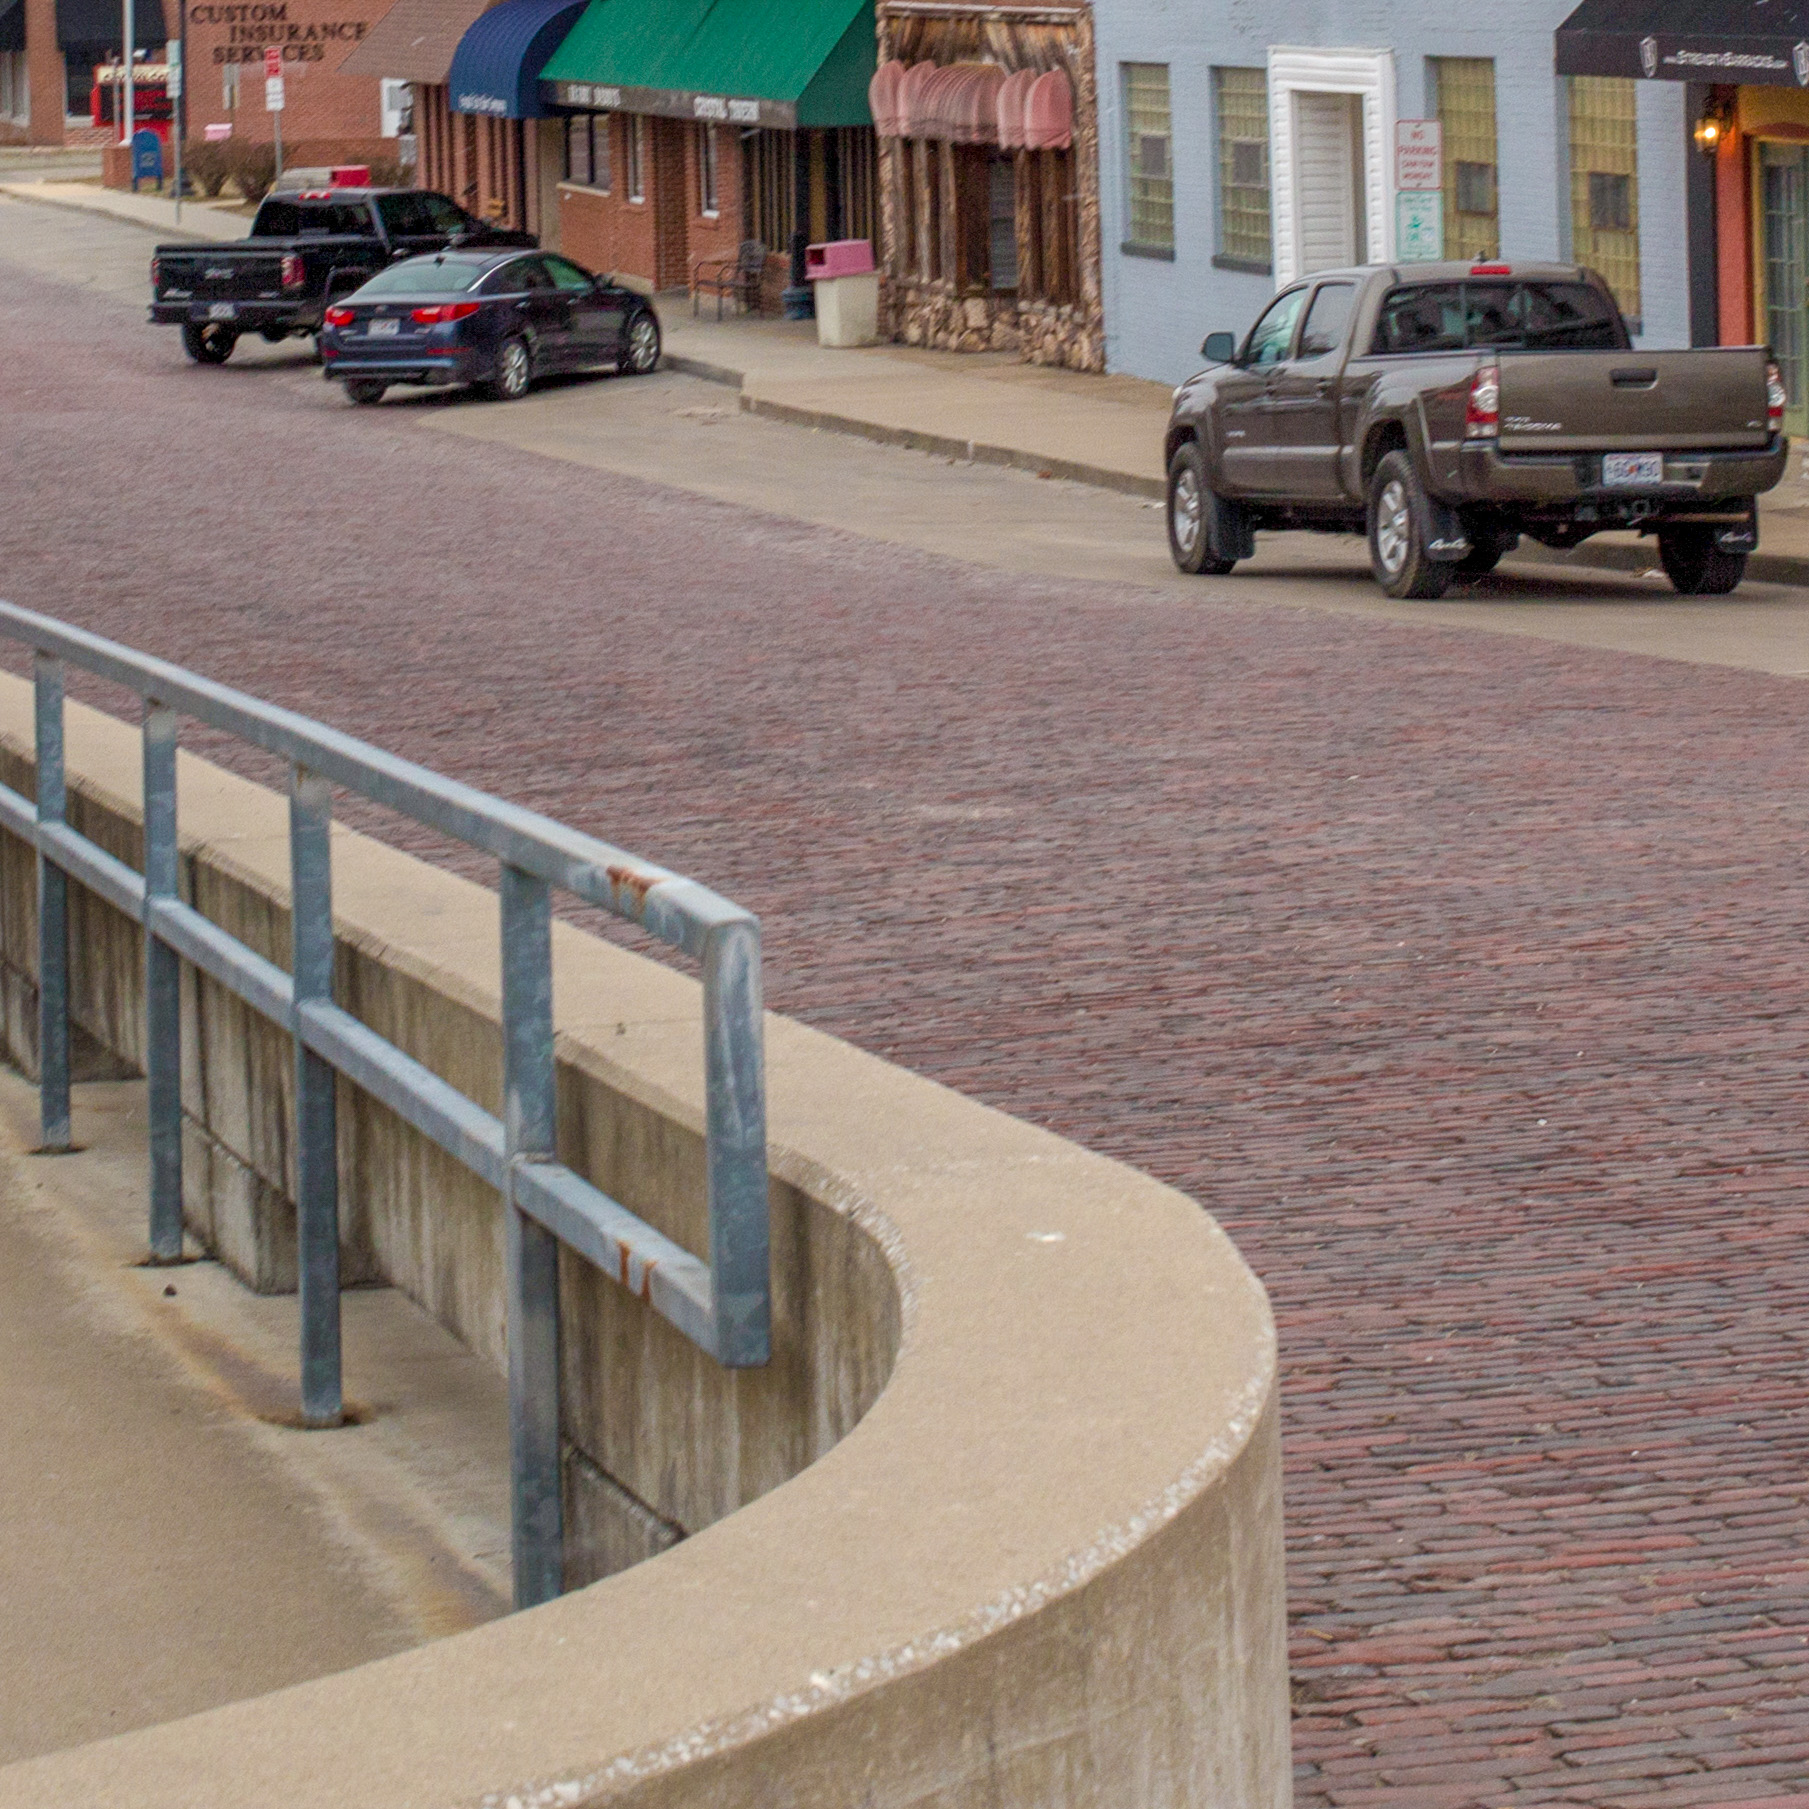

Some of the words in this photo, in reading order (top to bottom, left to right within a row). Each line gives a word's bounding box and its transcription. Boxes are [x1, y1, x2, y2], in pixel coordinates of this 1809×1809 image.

[190, 4, 288, 25] CUSTOM
[229, 21, 368, 43] INSURANCE
[213, 44, 325, 64] SERVCES
